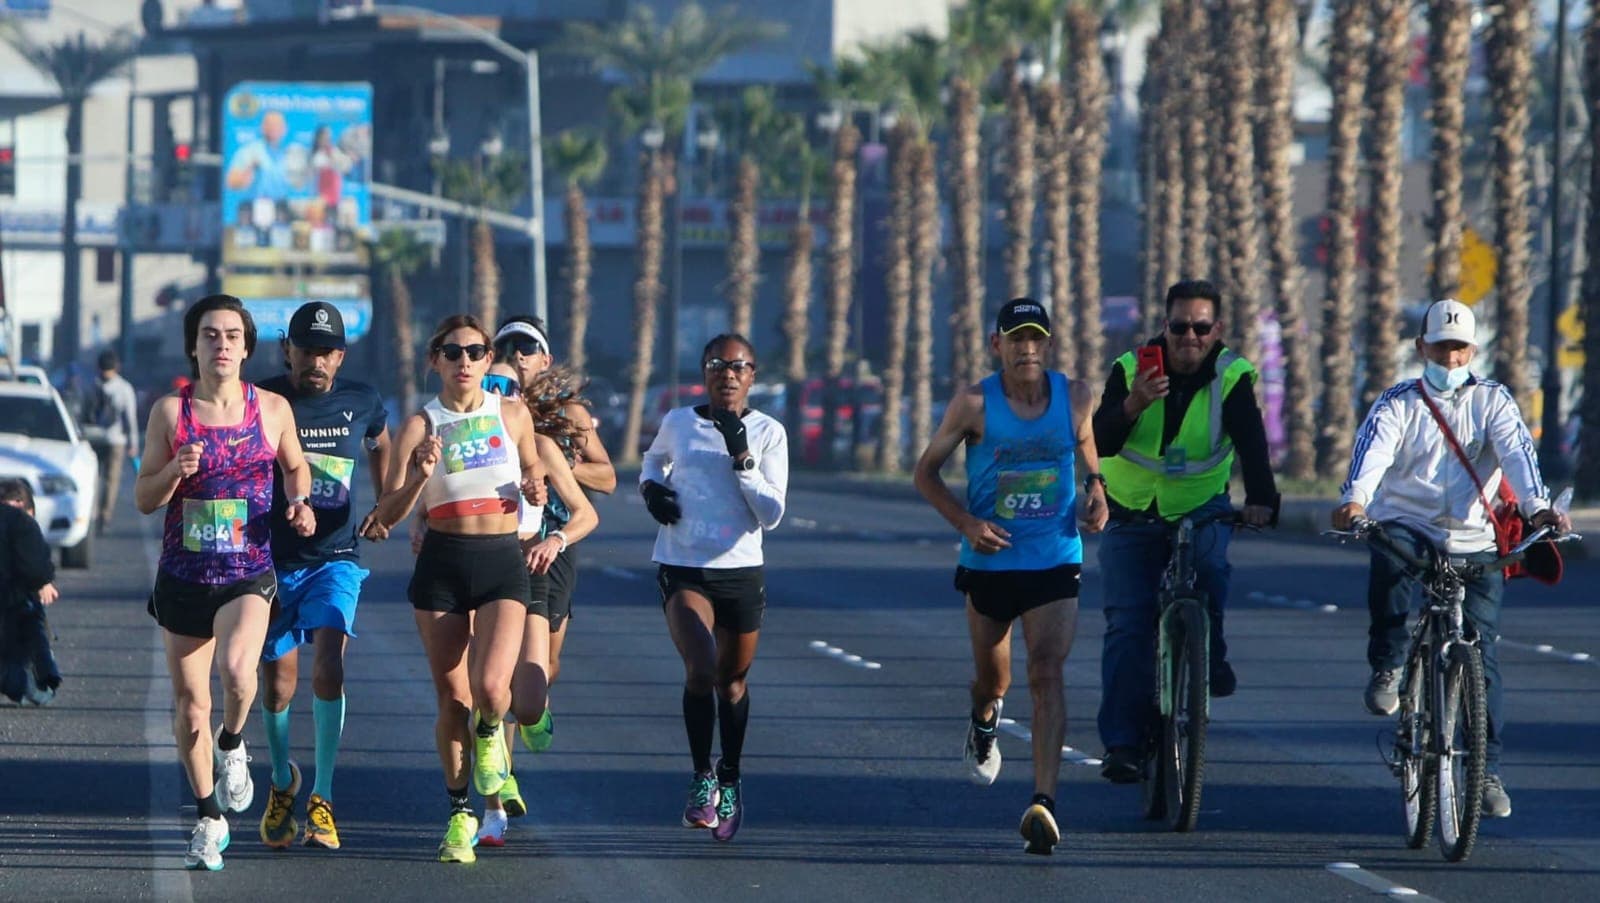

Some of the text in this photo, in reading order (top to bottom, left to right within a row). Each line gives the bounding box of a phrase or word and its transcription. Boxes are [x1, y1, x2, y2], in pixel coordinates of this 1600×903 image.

[299, 427, 350, 438] UNNING
[449, 438, 489, 461] 233
[312, 478, 336, 498] 83
[1004, 493, 1042, 510] 673
[189, 523, 230, 542] 484
